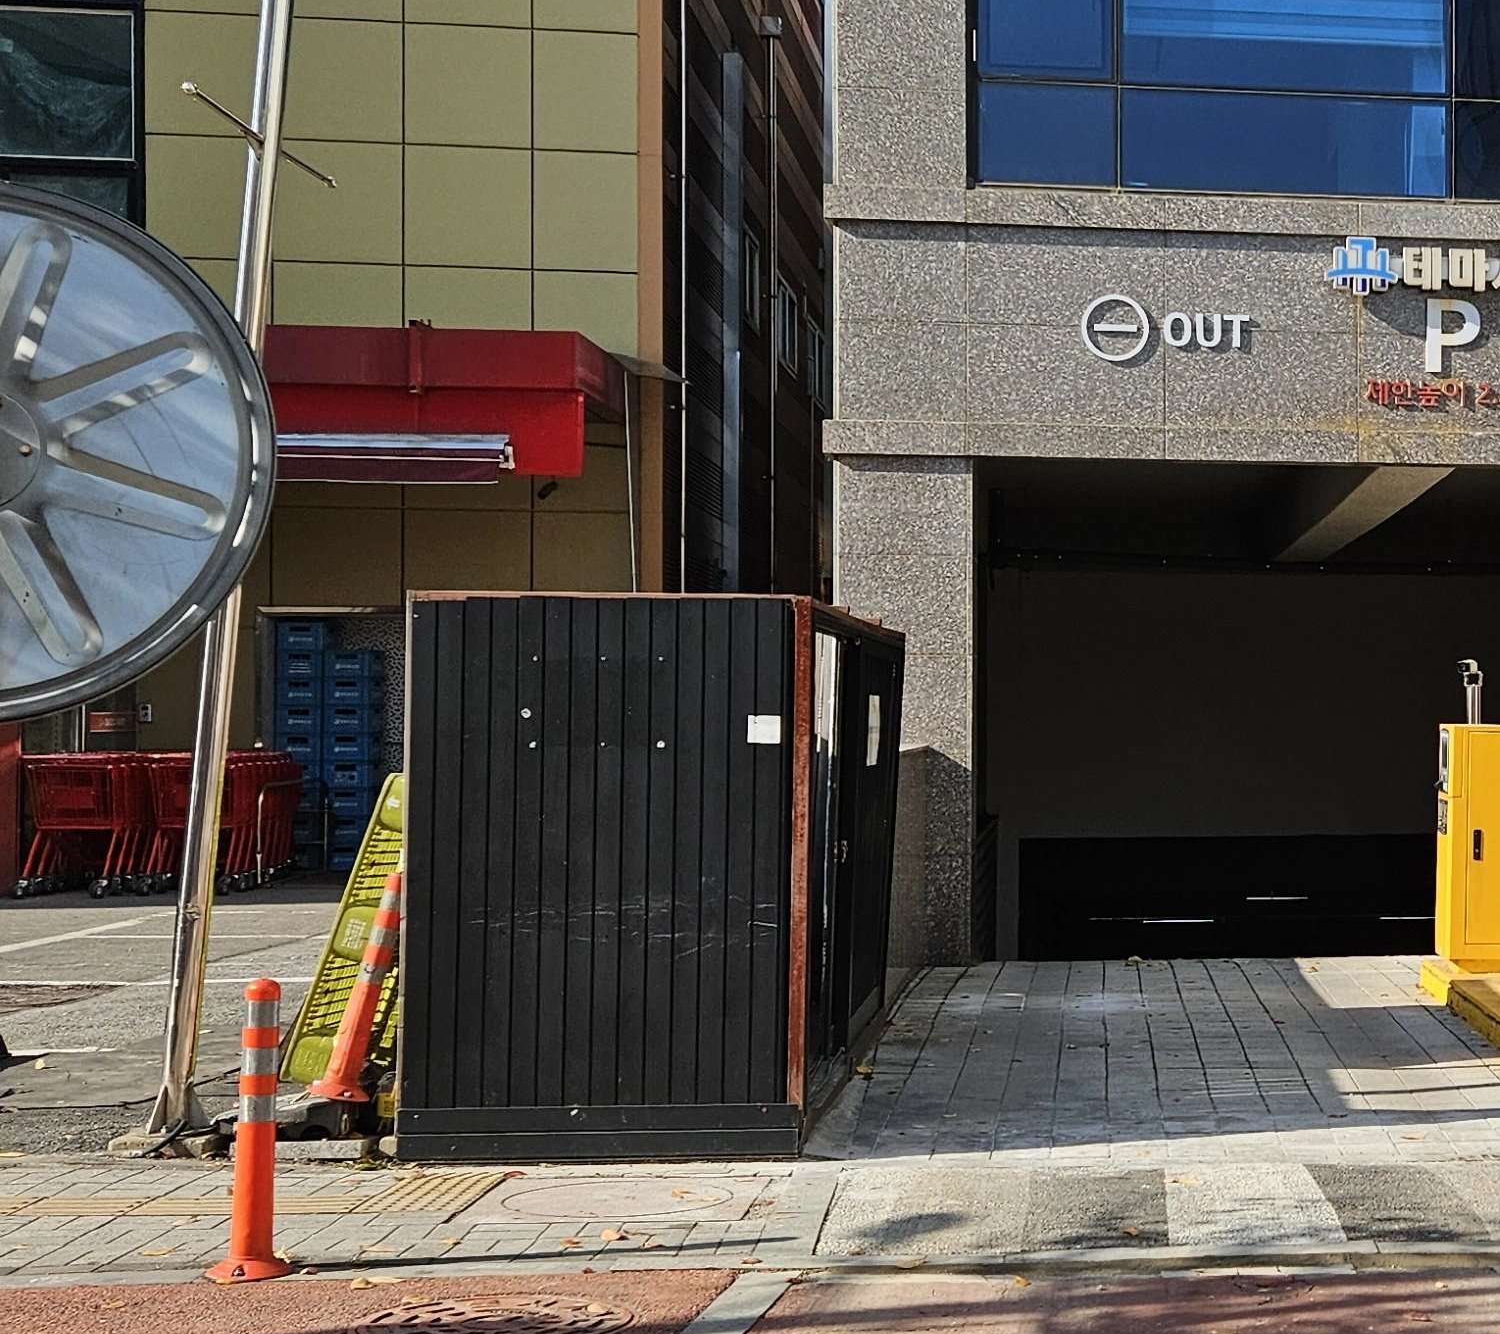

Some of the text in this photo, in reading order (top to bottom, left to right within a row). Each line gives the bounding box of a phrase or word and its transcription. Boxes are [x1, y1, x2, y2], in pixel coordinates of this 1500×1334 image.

[1163, 312, 1250, 347] OUT
[1425, 298, 1481, 373] P
[1365, 378, 1466, 408] 제한높이
